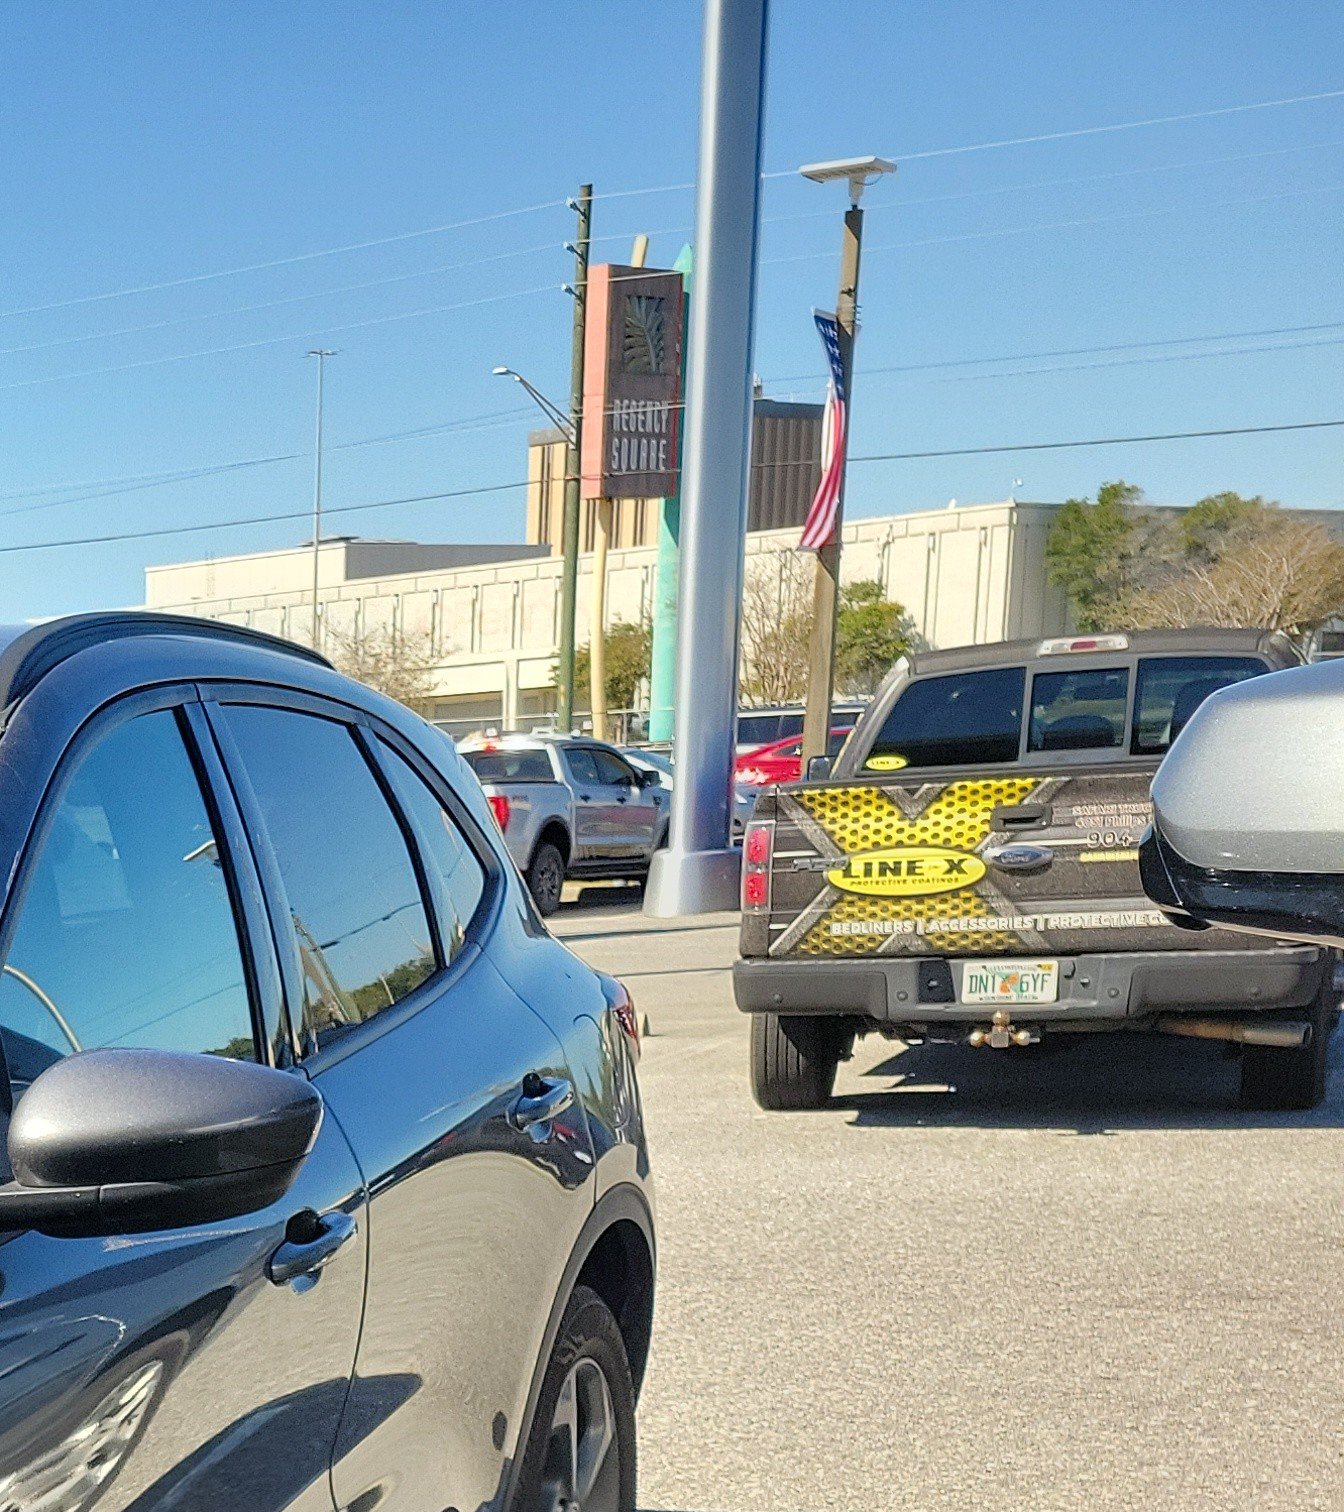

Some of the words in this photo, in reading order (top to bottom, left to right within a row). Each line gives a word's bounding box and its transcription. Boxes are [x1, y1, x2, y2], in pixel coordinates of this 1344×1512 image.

[613, 399, 668, 433] REGENCY
[612, 437, 666, 472] SQUARE
[849, 878, 907, 887] PROTECTIVE
[911, 876, 960, 886] COATINGS
[831, 920, 913, 936] BEDLINERS
[926, 915, 1033, 934] ACCESSORIES
[1047, 910, 1145, 929] PROTECTIVE
